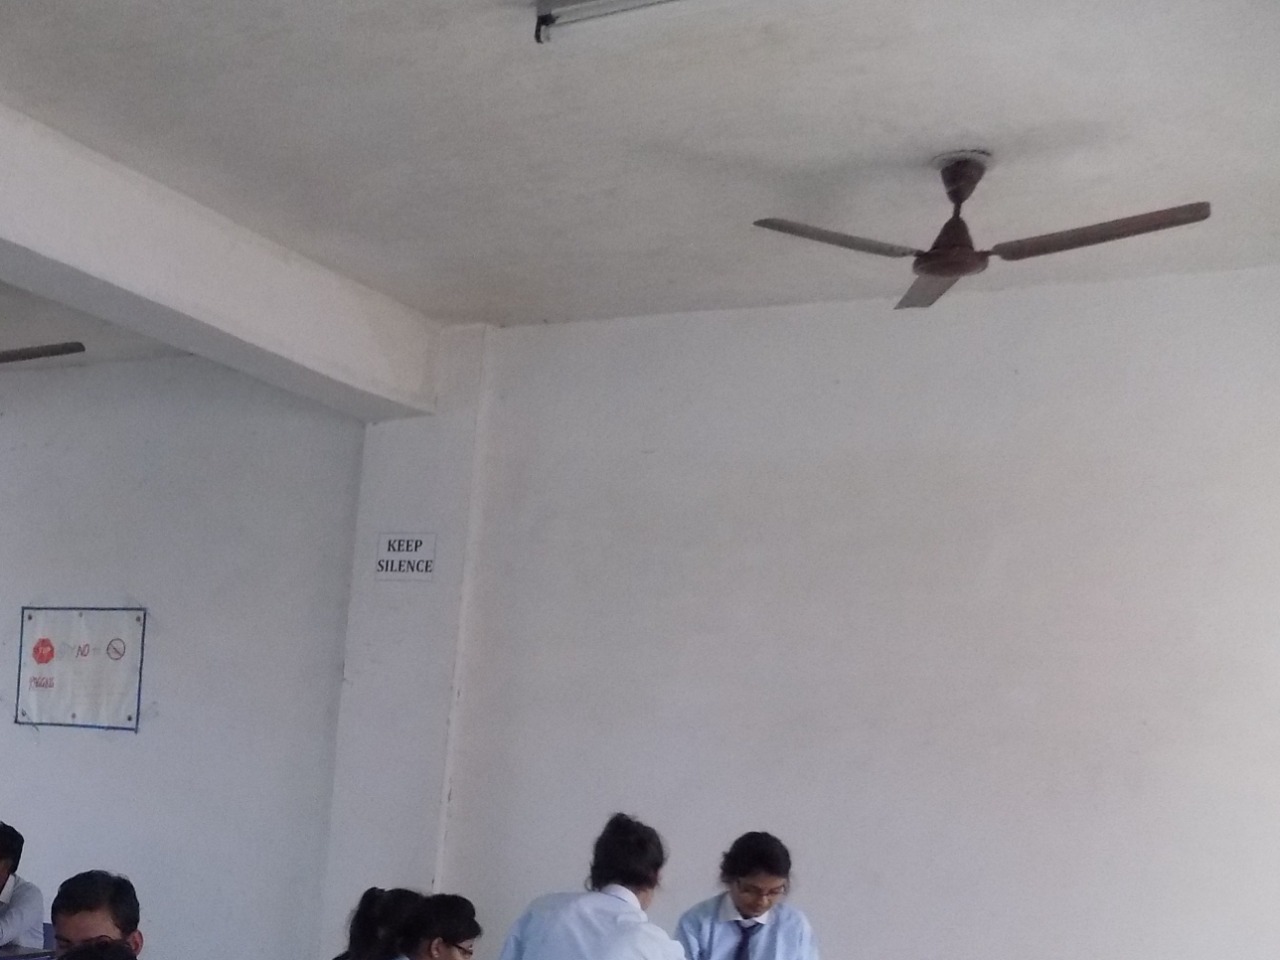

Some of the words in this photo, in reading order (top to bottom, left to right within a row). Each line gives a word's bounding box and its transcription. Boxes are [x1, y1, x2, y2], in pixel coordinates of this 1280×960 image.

[387, 539, 423, 552] KEEP
[376, 559, 433, 573] SILENCE
[76, 643, 90, 658] NO
